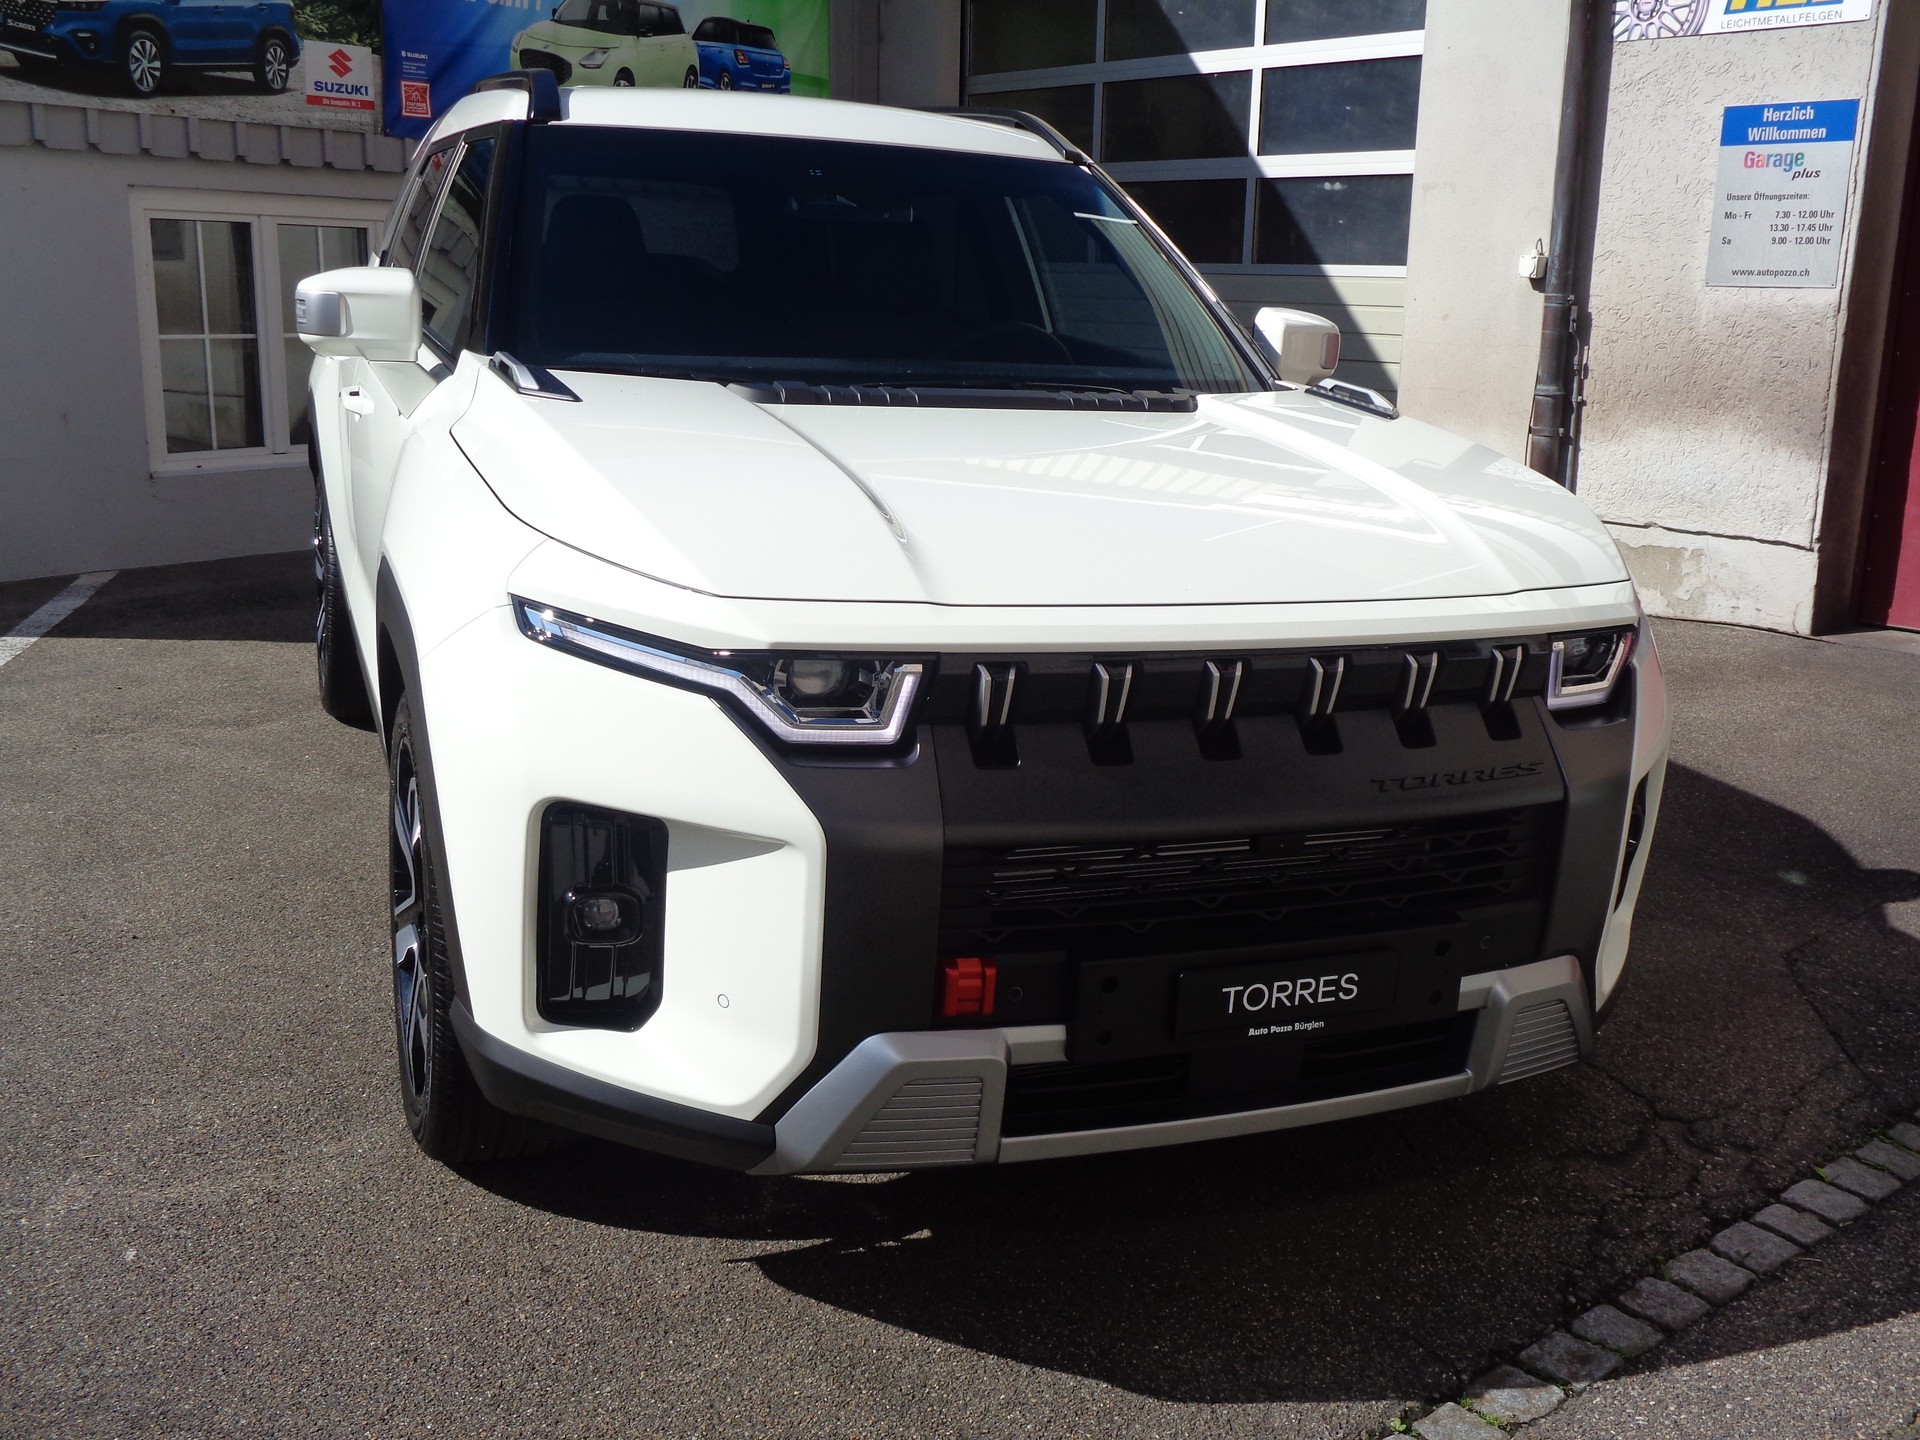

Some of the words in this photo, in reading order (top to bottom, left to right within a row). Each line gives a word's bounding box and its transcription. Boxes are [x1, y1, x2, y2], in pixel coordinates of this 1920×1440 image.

[1720, 10, 1843, 29] LEICHTMETALLFELGEN
[406, 52, 428, 60] SUZUKI
[313, 80, 369, 96] SUZUKI
[1763, 105, 1814, 122] Herzlich
[1748, 126, 1827, 142] Willkommen
[1743, 151, 1805, 172] Garage
[1791, 167, 1821, 181] plus
[1726, 193, 1752, 201] Unsere
[1753, 191, 1810, 202] Öffnungszeiten:
[1724, 211, 1737, 220] Mo
[1744, 211, 1752, 219] Fr
[1775, 210, 1791, 219] 7.30
[1798, 210, 1818, 219] 12.00
[1819, 210, 1834, 219] Uhr
[1769, 223, 1789, 232] 13.30
[1796, 223, 1816, 232] 17.45
[1818, 223, 1833, 232] Uhr
[1721, 236, 1732, 245] Sa
[1771, 236, 1787, 245] 9.00
[1794, 236, 1814, 245] 12.00
[1816, 236, 1831, 245] Uhr
[1731, 268, 1810, 278] www.autopozzo.ch
[1370, 762, 1545, 793] TORRES
[1221, 973, 1359, 1014] TORRES
[1248, 1027, 1268, 1037] Auto
[1294, 1021, 1325, 1031] Bürglen
